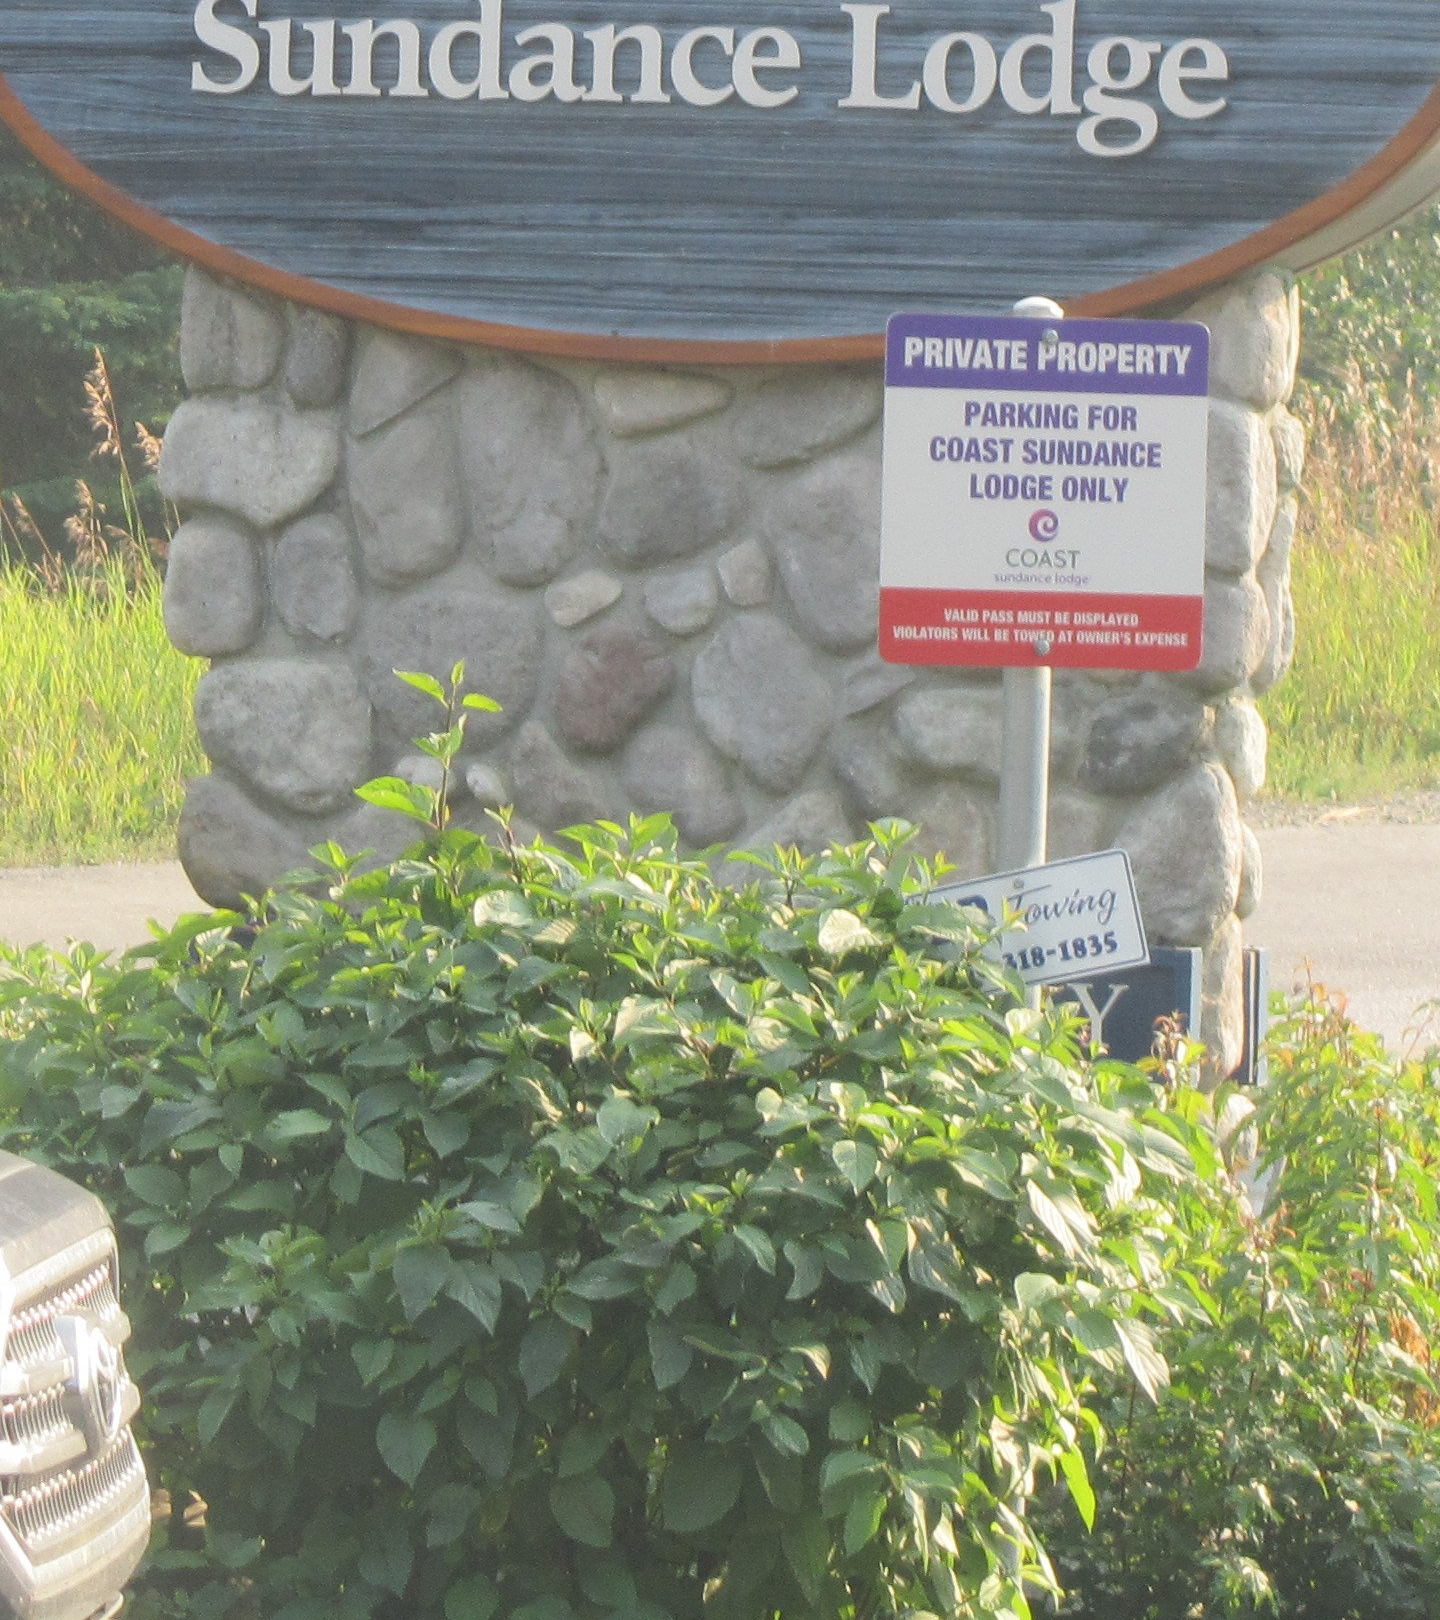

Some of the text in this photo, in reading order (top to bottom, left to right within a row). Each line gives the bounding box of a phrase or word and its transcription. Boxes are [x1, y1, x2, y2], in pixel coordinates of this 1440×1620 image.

[904, 336, 1192, 375] PRIVATE PROPERTY
[963, 400, 1138, 432] PARKING FOR
[929, 435, 1162, 468] COAST SUNDANCE
[969, 473, 1129, 503] LODGE ONLY
[1005, 548, 1081, 570] COAST
[994, 572, 1090, 586] sundance lodge
[944, 608, 1139, 627] VALID PASS MUST BE DISPLAYED
[893, 625, 1188, 647] VIOLATORS WILL BE TOWED AT OWNER'S EXPENSE
[1007, 884, 1117, 925] Towing
